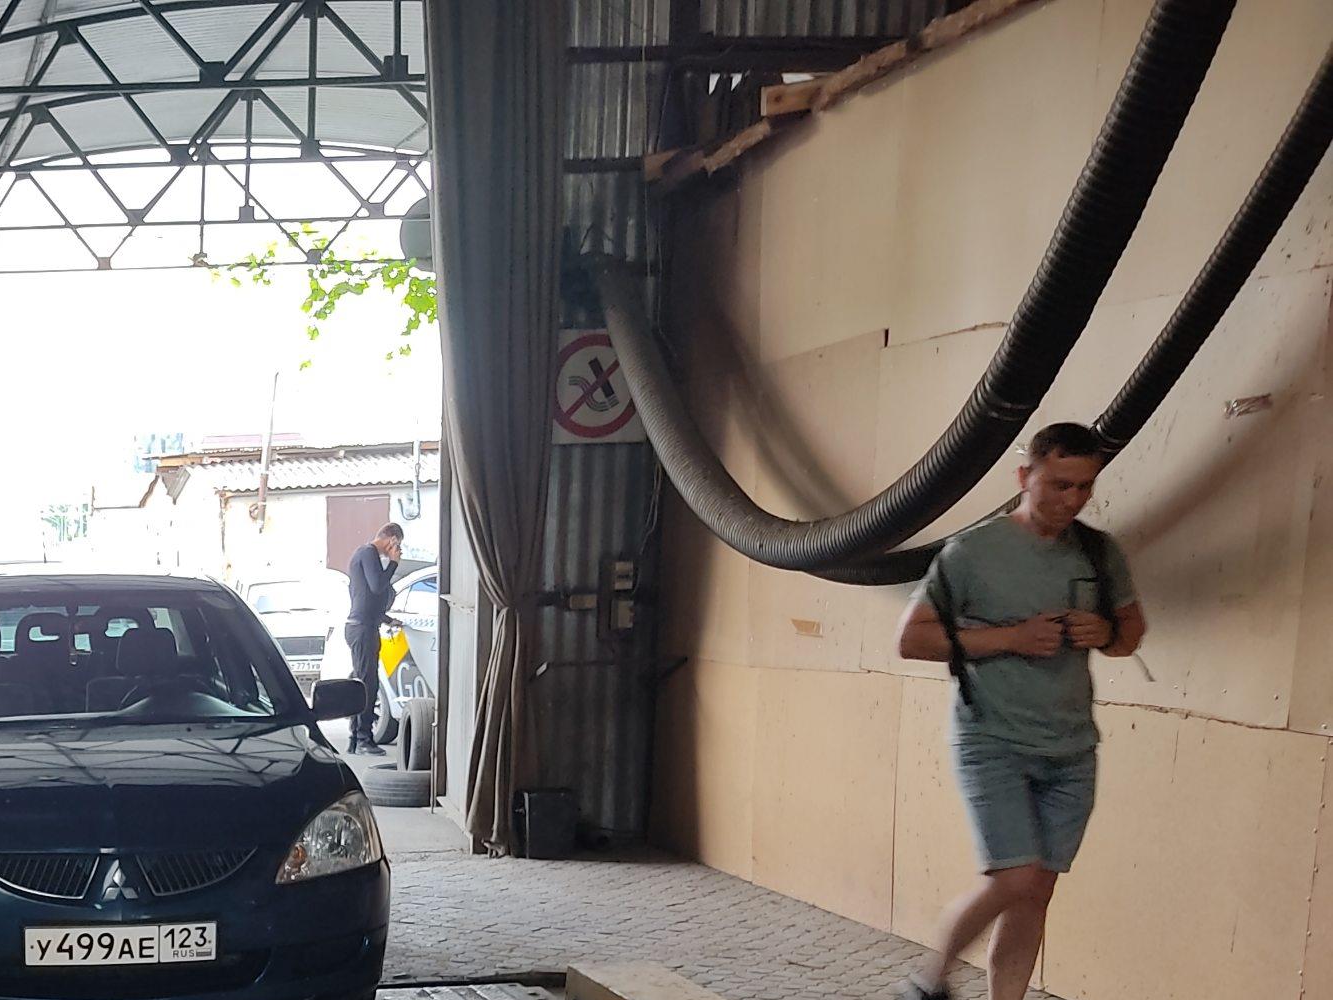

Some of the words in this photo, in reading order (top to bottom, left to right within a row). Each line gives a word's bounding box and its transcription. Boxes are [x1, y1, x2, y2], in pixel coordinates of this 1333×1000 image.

[36, 932, 155, 961] У499АЕ
[164, 926, 208, 950] 123
[172, 949, 195, 959] RUS
